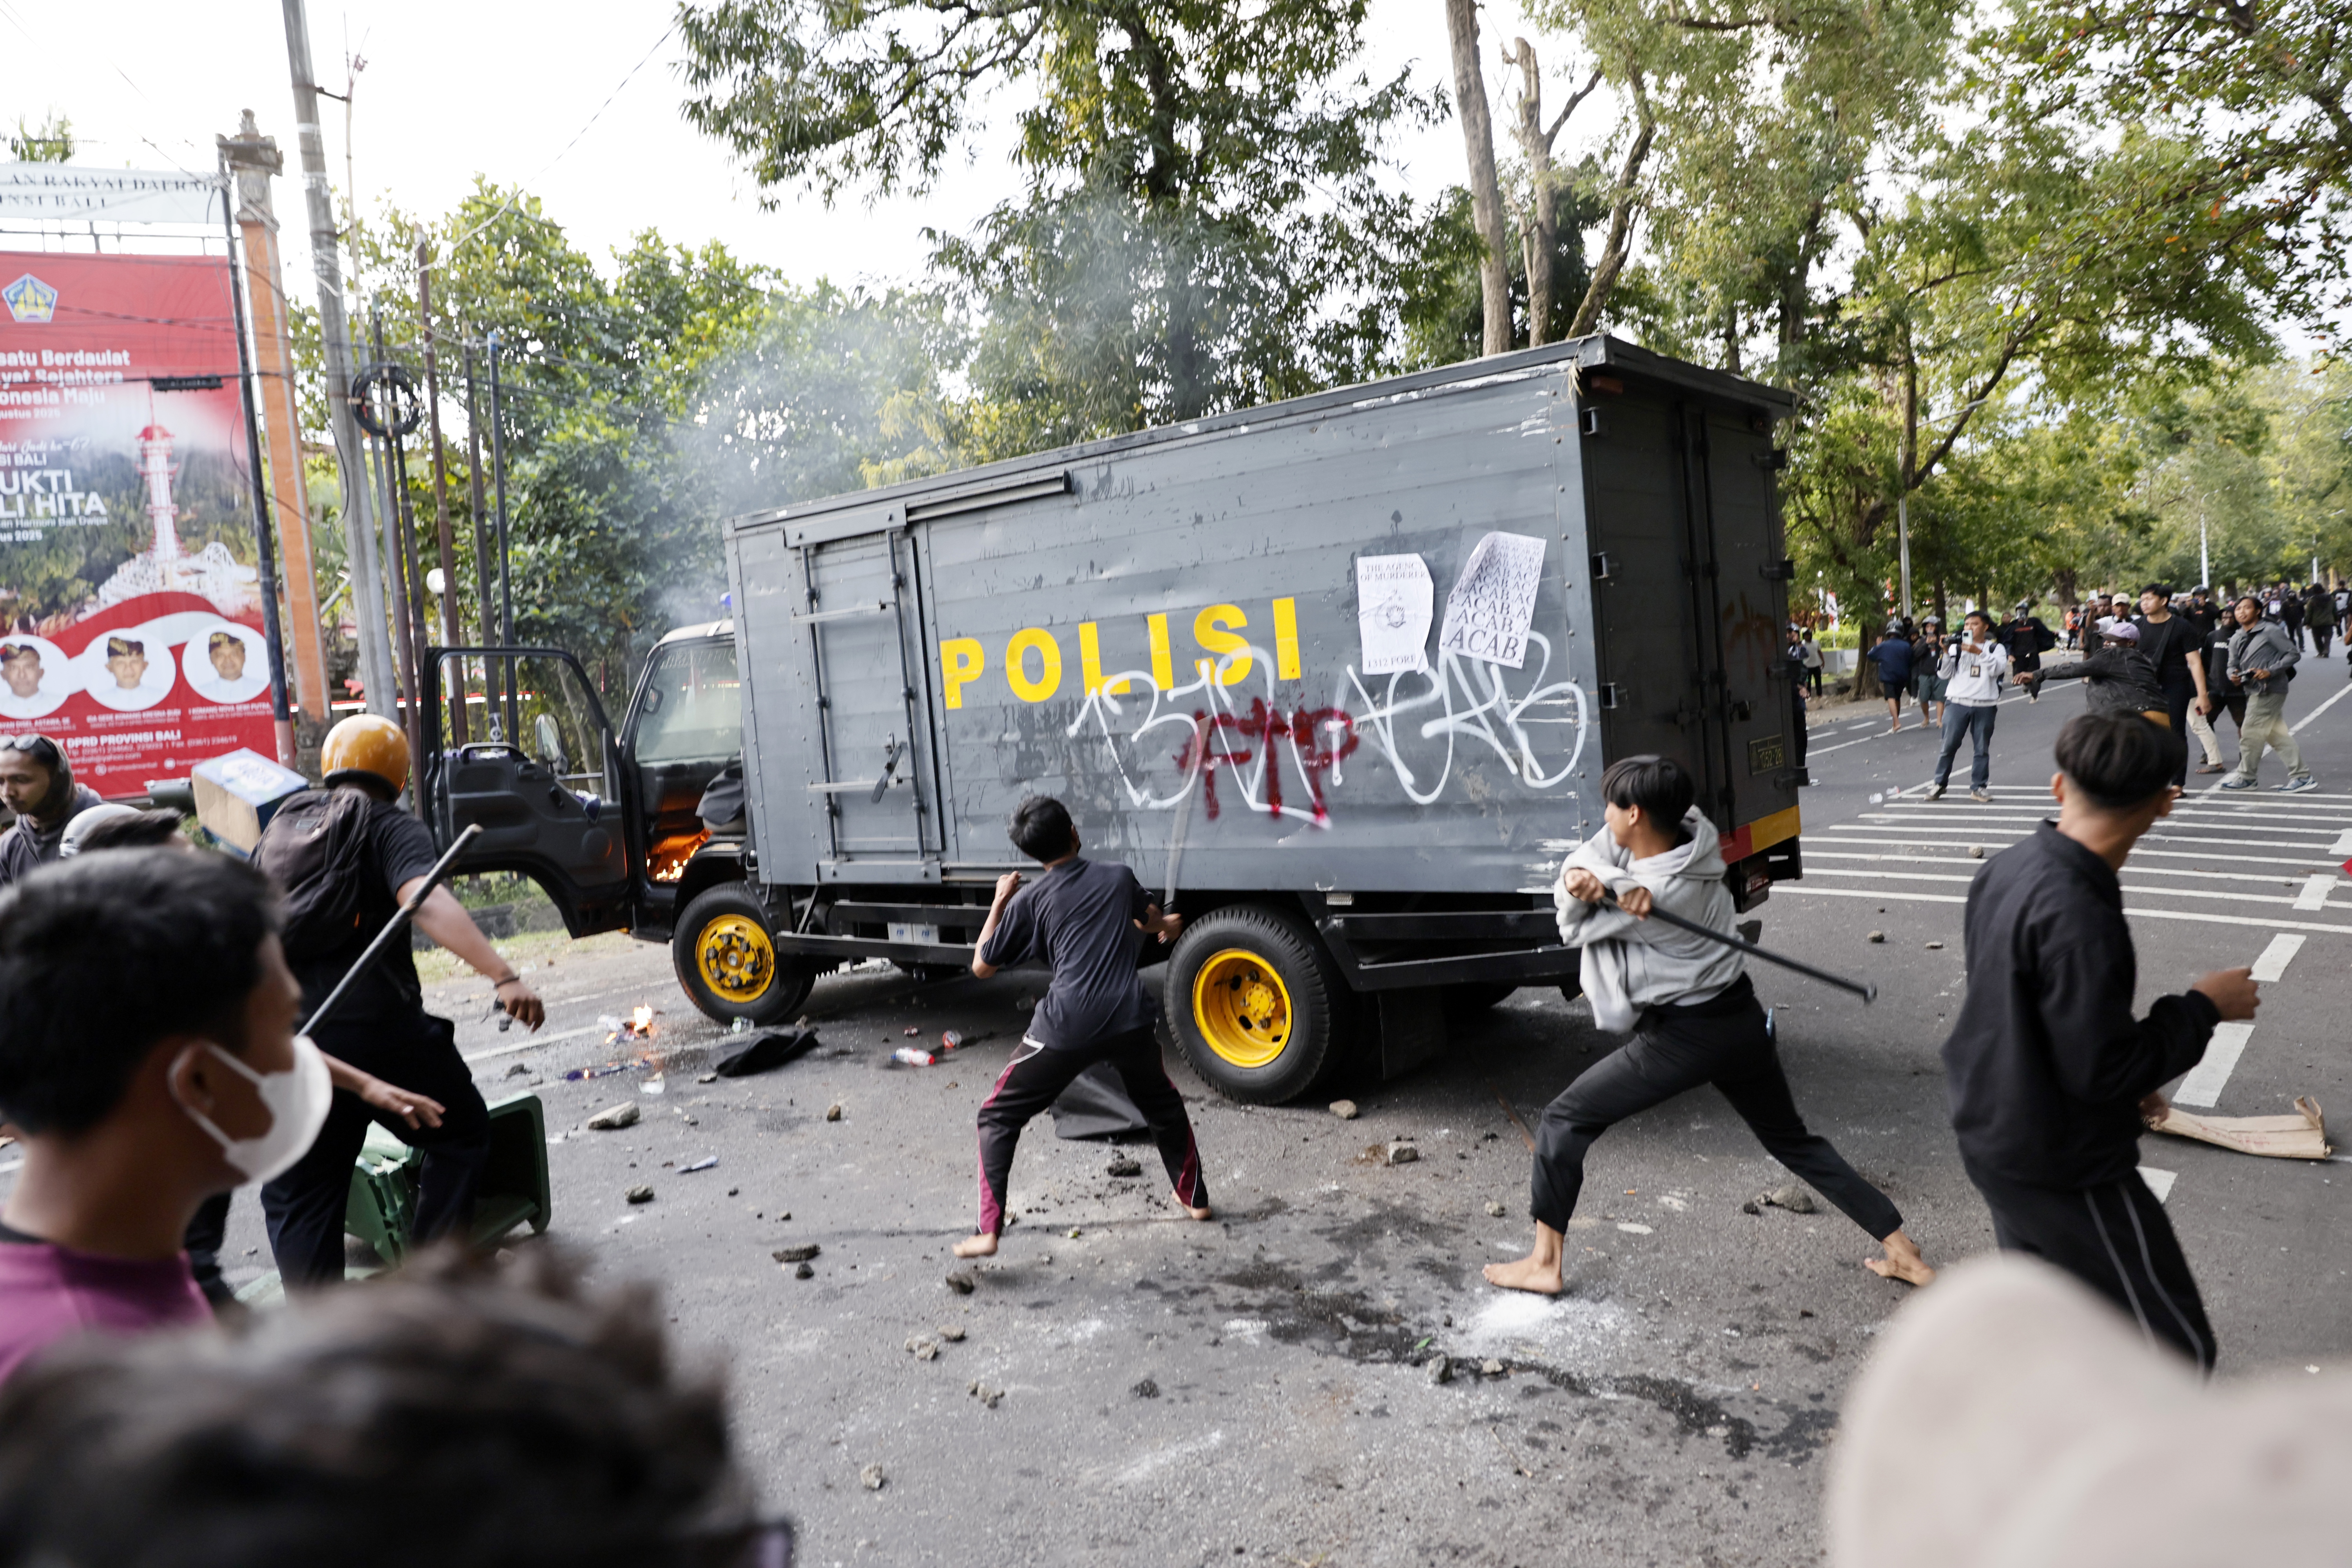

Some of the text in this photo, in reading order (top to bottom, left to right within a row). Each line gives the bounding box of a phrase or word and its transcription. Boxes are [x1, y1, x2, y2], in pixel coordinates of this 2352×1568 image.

[44, 174, 127, 191] RAKYAT
[54, 196, 105, 210] BALI
[41, 349, 131, 367] Berdaulat
[0, 368, 123, 390] yat Sejahtera
[63, 387, 105, 408] Maju
[0, 408, 32, 419] ustus
[14, 453, 47, 466] BALI
[34, 491, 107, 517] HITA
[58, 517, 77, 526] Bali
[15, 529, 43, 541] 2025
[1365, 563, 1383, 572] THE
[1360, 572, 1373, 582] OF
[940, 597, 1301, 710] POLISI
[1368, 657, 1388, 668] 1312
[66, 736, 98, 749] DPRD
[100, 731, 154, 746] PROVINSI
[155, 729, 181, 741] BALI
